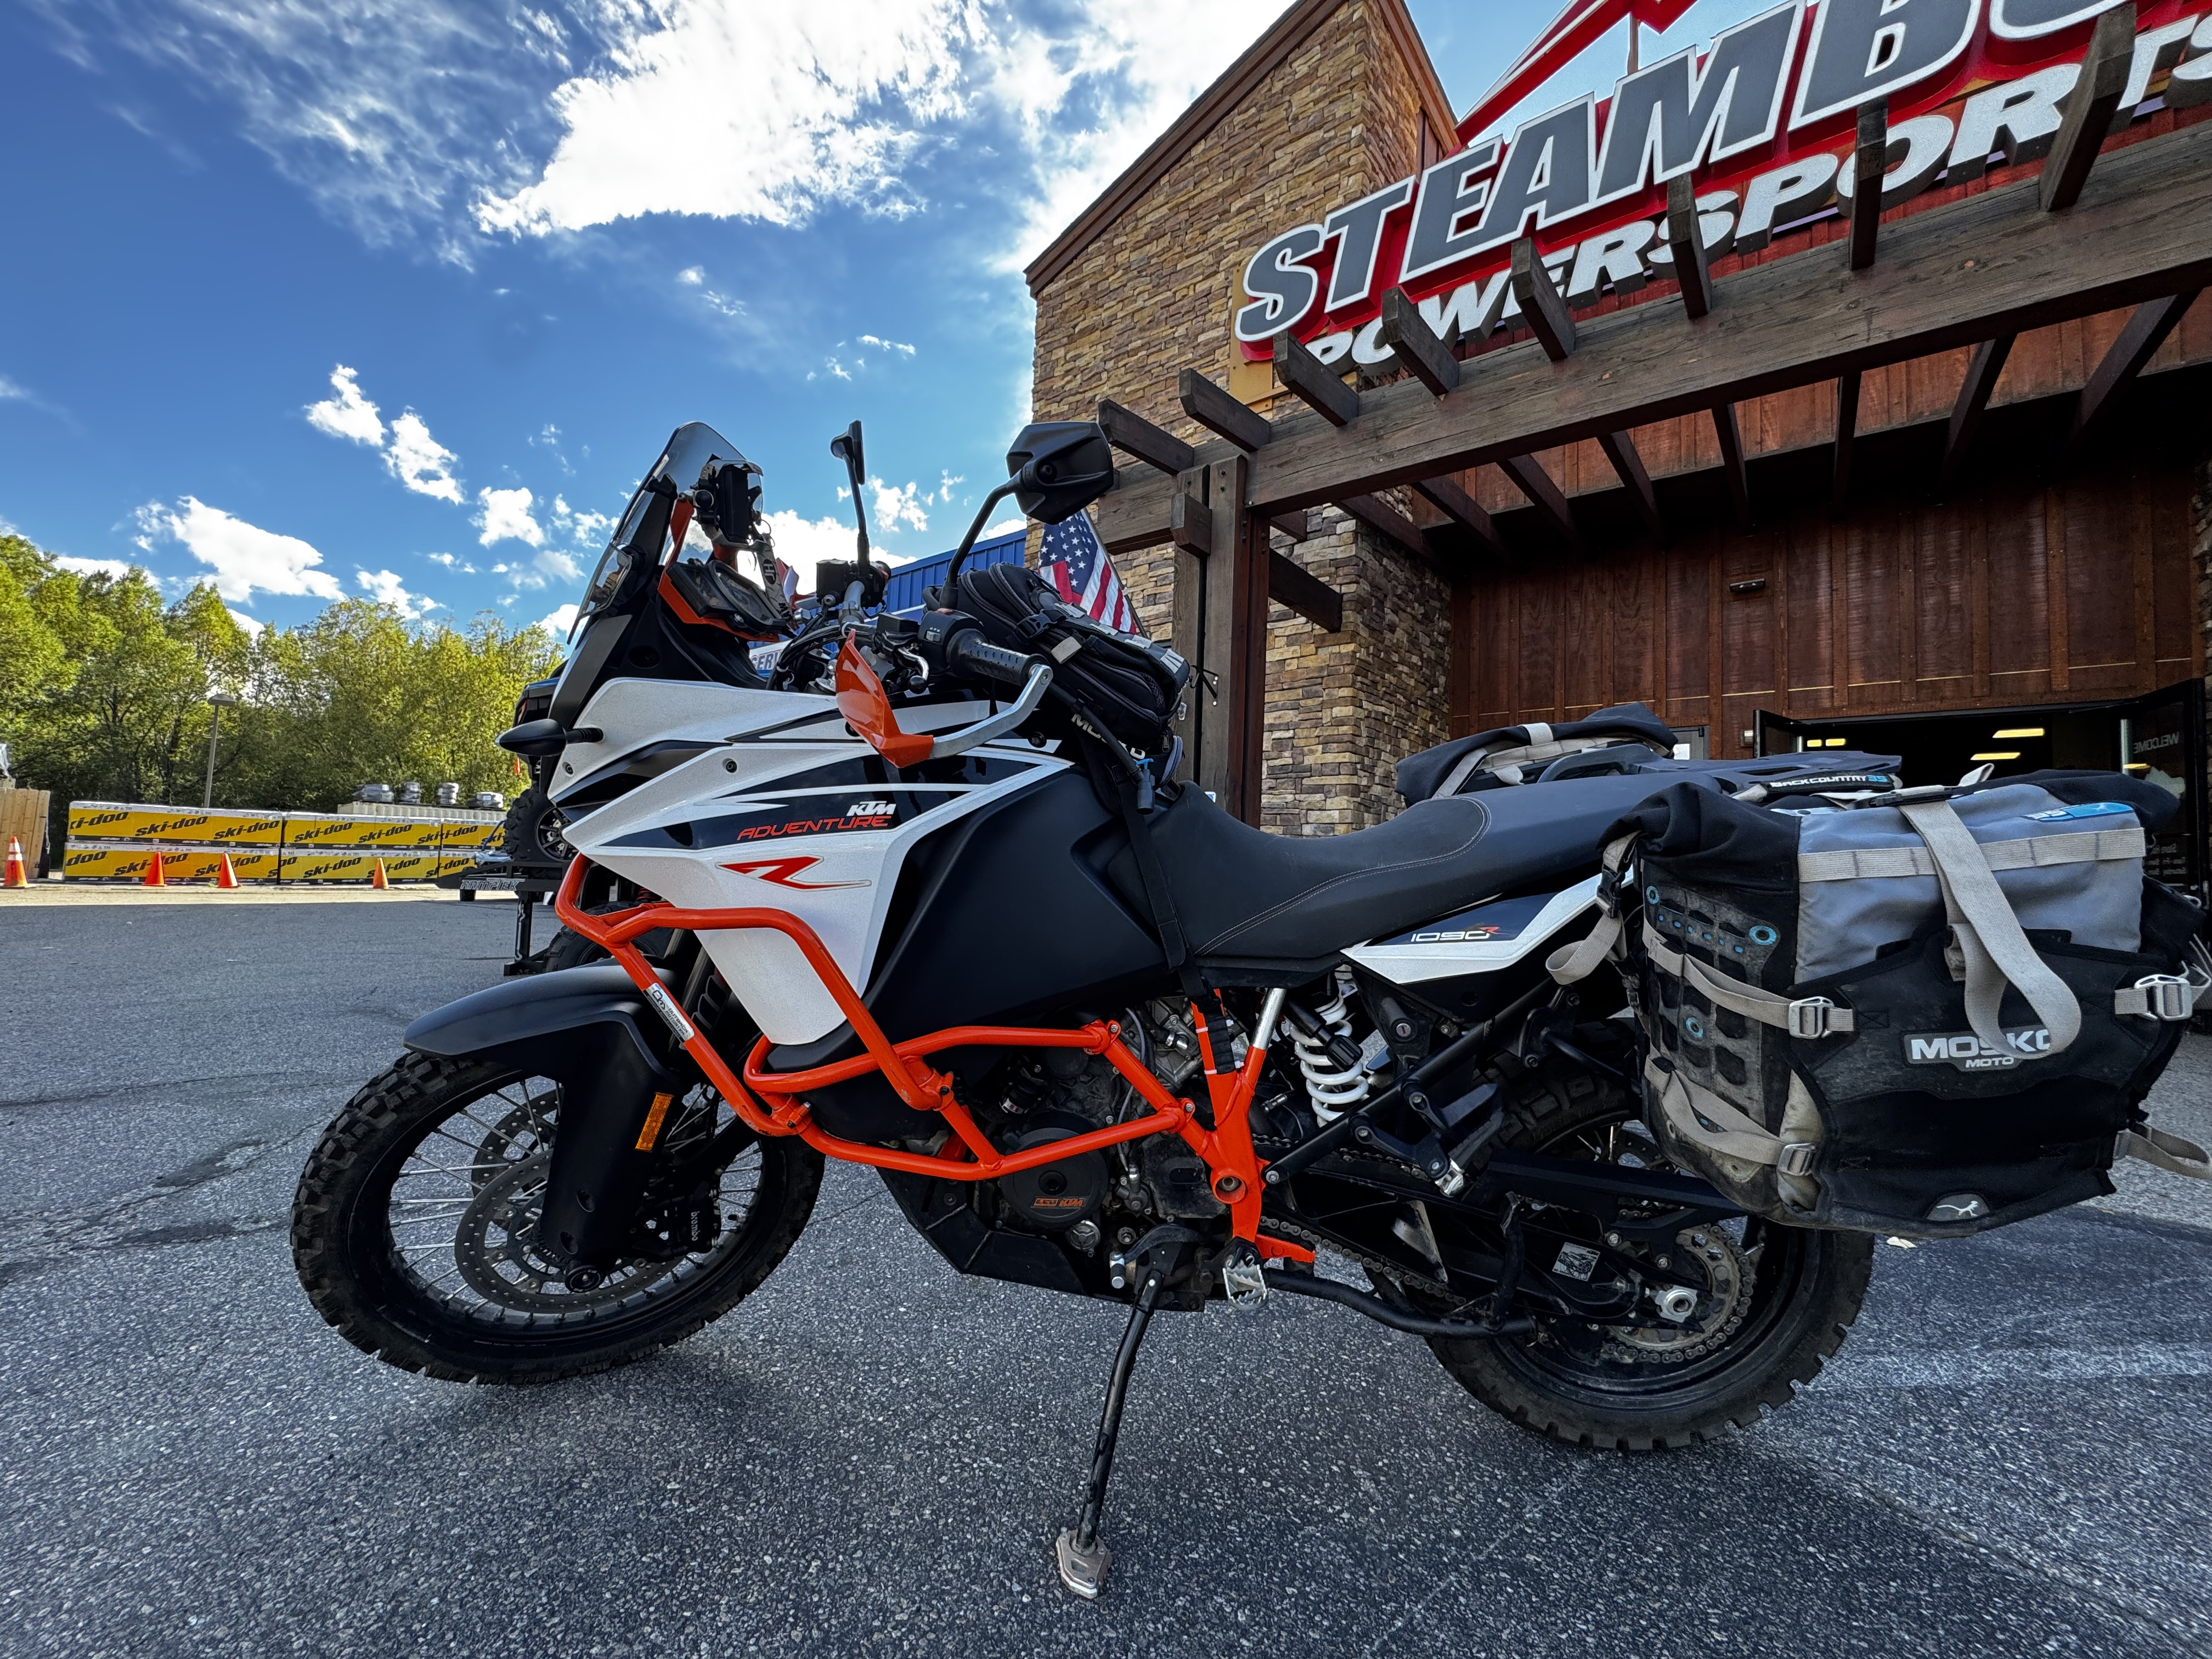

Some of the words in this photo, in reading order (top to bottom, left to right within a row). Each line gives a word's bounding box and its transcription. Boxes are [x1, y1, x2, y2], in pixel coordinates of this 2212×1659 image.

[1235, 0, 2130, 342] STEAMB
[846, 801, 896, 816] KTM
[135, 816, 208, 837] ski-doo
[213, 820, 280, 840] ski-doo
[294, 822, 353, 842] ski-doo
[358, 824, 413, 843] ski-doo
[736, 815, 891, 840] ADVENTURE
[303, 857, 362, 878] ski-doo
[1965, 1057, 2015, 1068] MOTO
[691, 1210, 701, 1242] brembo
